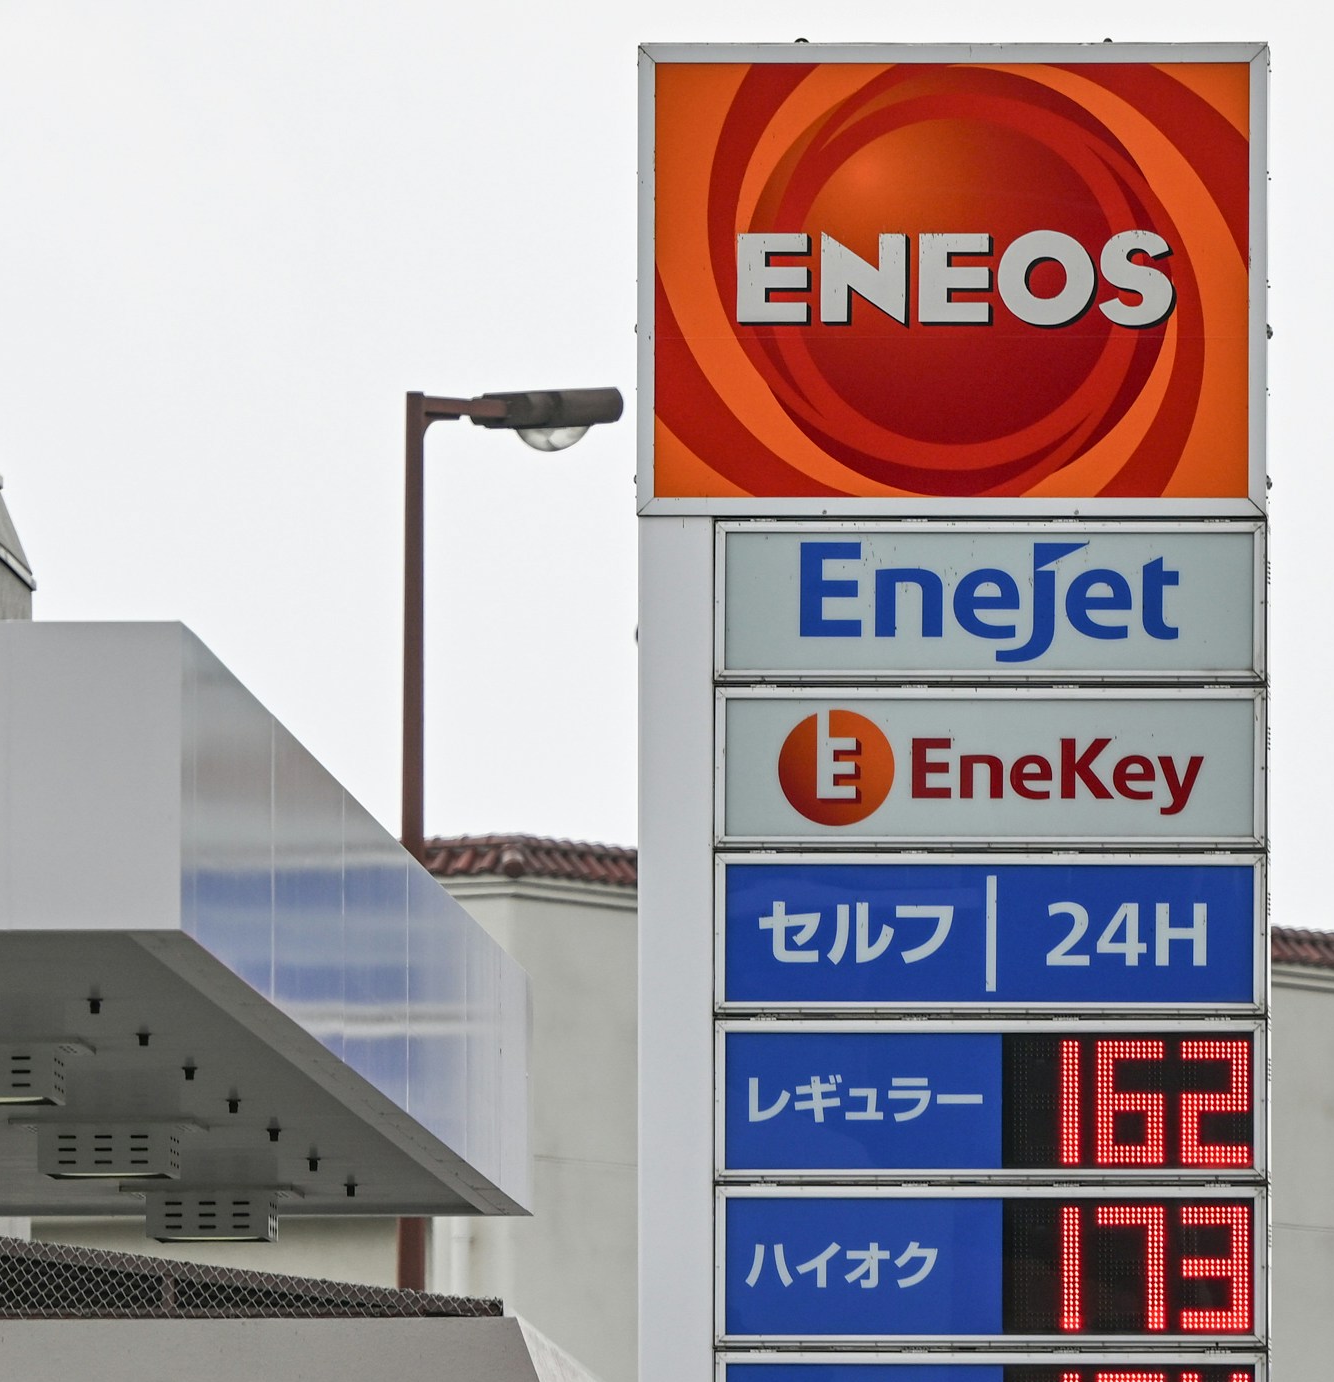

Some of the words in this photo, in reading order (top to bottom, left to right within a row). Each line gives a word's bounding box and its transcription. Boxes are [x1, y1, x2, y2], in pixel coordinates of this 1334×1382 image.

[735, 229, 1177, 328] ENEOS
[798, 541, 1180, 664] Enejet
[911, 736, 1205, 816] EneKey
[759, 902, 954, 965] セルフ
[1046, 902, 1208, 968] 24H
[746, 1075, 983, 1124] レギュラー
[1059, 1039, 1250, 1165] 162
[745, 1241, 938, 1288] ハイオク
[1059, 1206, 1250, 1330] 173
